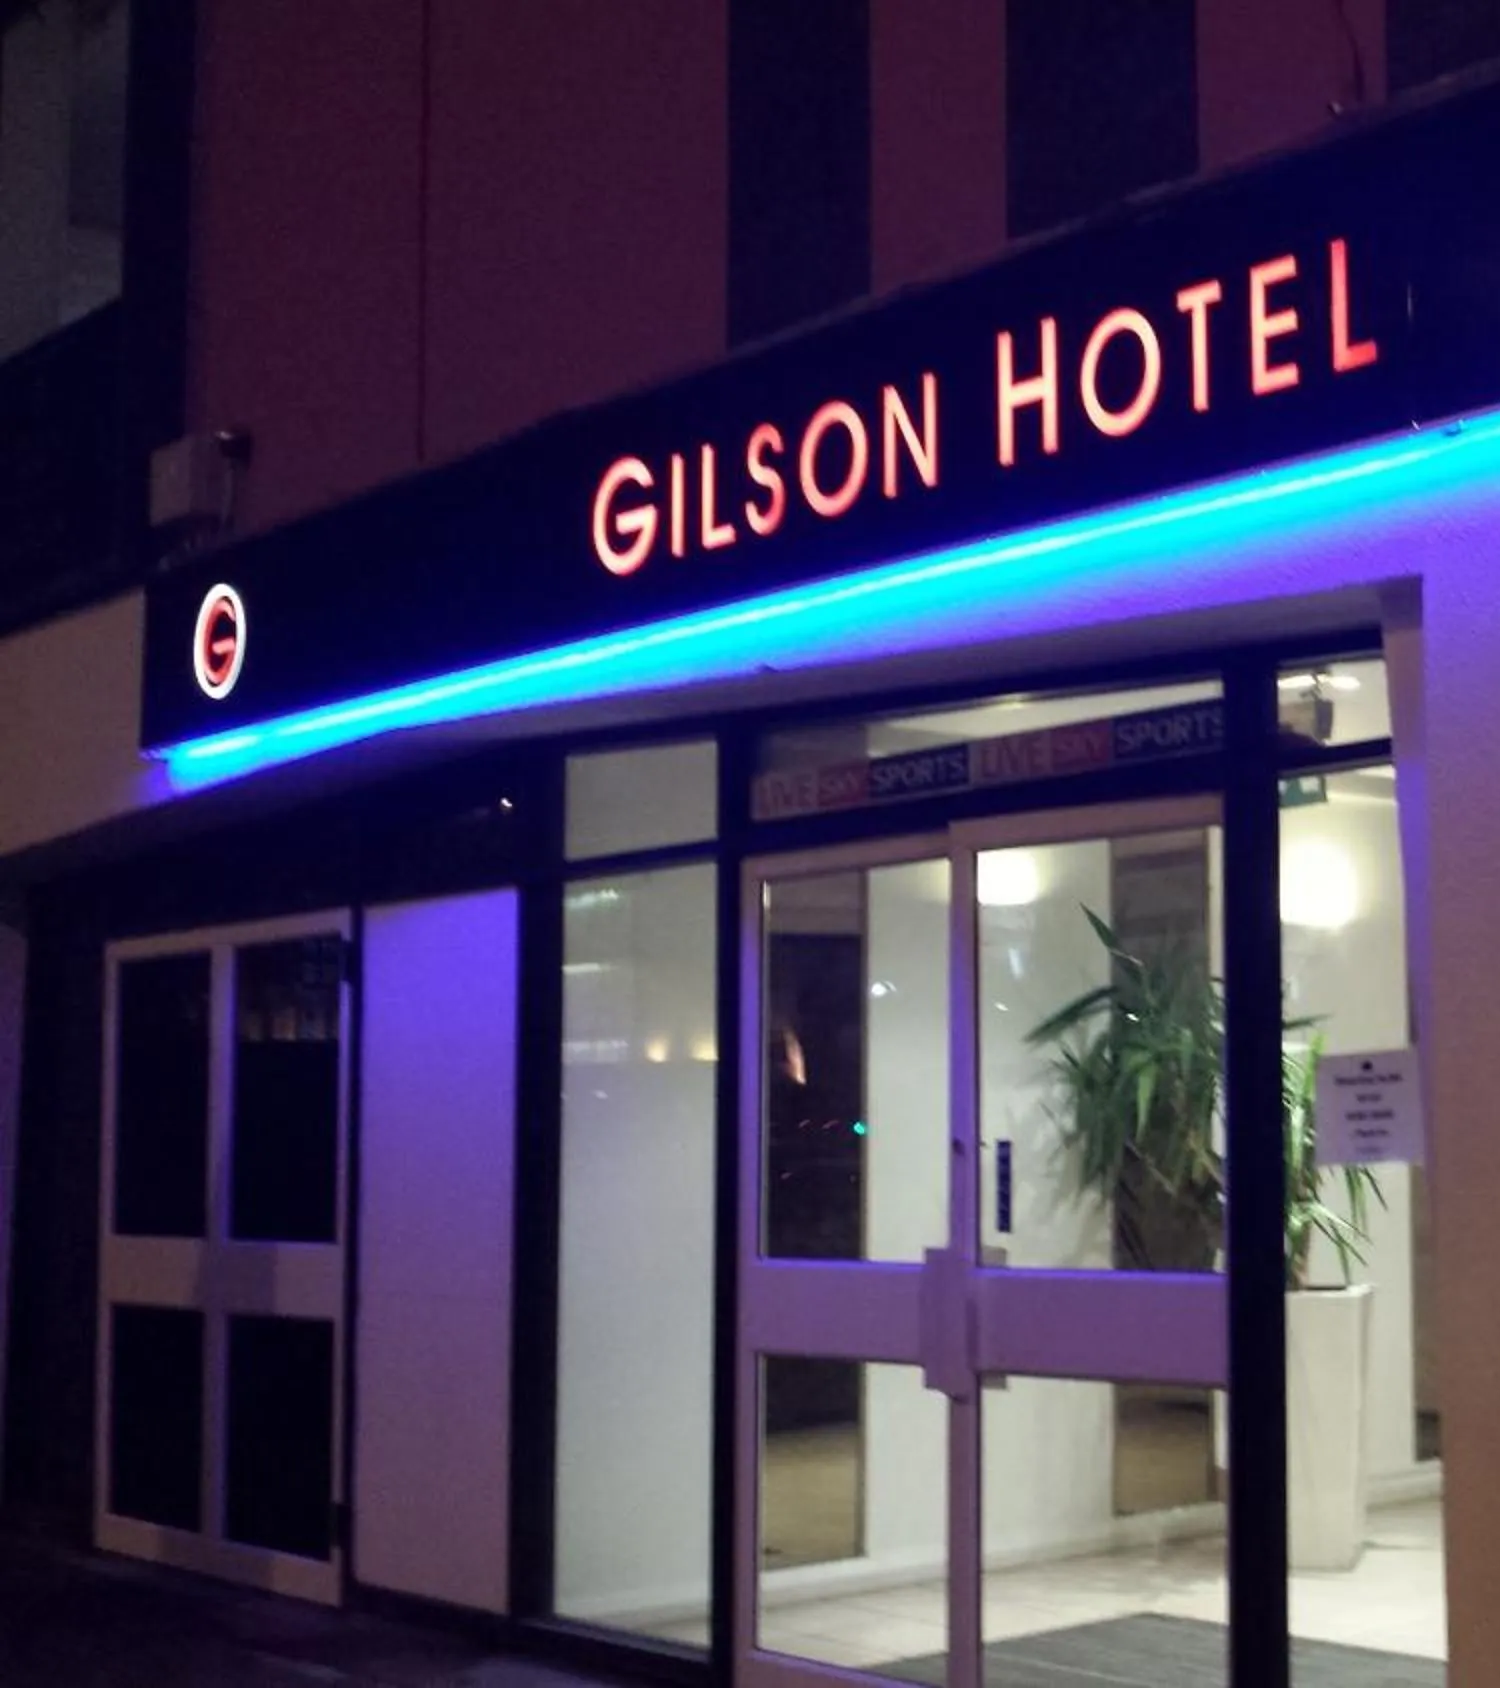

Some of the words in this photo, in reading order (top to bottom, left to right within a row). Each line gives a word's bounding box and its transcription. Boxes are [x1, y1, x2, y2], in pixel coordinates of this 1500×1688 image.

[592, 372, 938, 575] GILSON
[997, 239, 1379, 466] HOTEL
[201, 596, 238, 689] G
[872, 751, 965, 797] SPORTS
